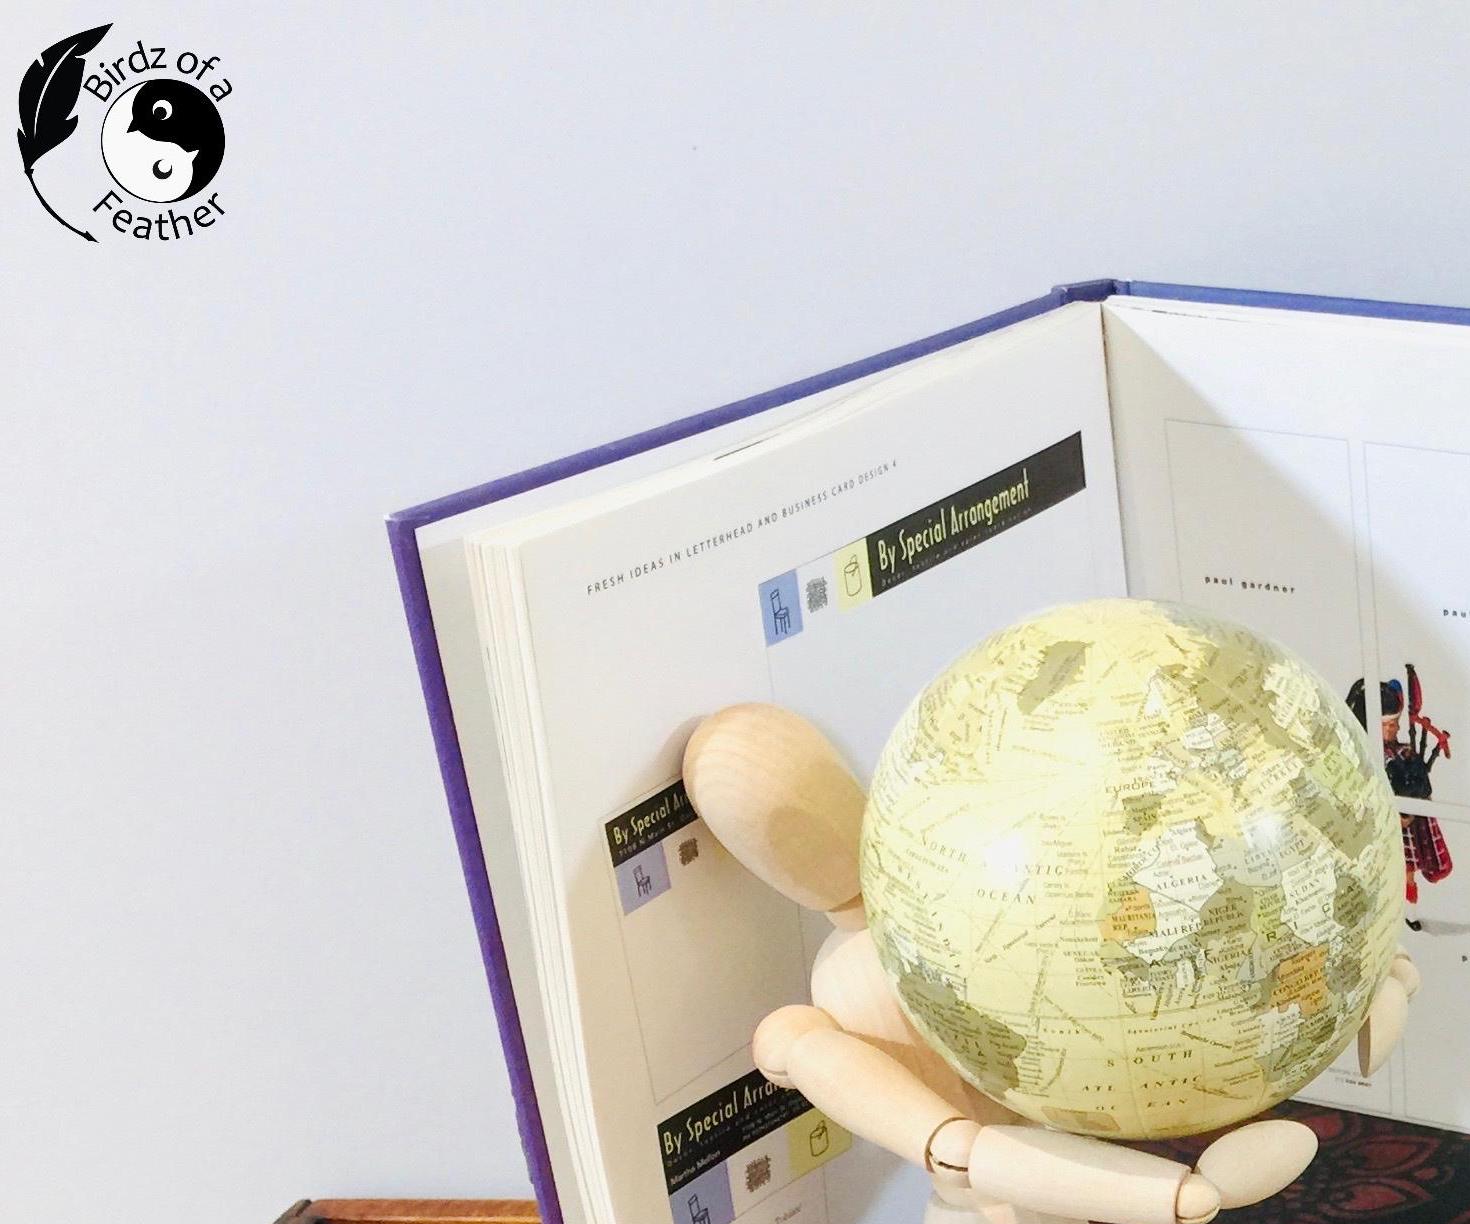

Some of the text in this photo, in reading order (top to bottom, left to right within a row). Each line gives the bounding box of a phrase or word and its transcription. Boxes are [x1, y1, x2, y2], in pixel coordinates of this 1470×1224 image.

[587, 574, 624, 595] FRESH
[630, 558, 665, 579] IDEAS
[669, 551, 681, 564] IN
[687, 523, 753, 557] LETTERHEAD
[758, 512, 778, 529] AND
[782, 492, 828, 518] BUSINESS
[831, 480, 855, 496] CARD
[858, 464, 889, 485] DESIGN
[877, 540, 896, 573] By
[899, 508, 946, 565] Special
[950, 468, 1029, 536] Arrangement
[1204, 575, 1296, 595] paul gardner
[613, 827, 628, 845] By
[631, 797, 670, 837] Special
[663, 1132, 682, 1156] By
[686, 1091, 738, 1142] Special
